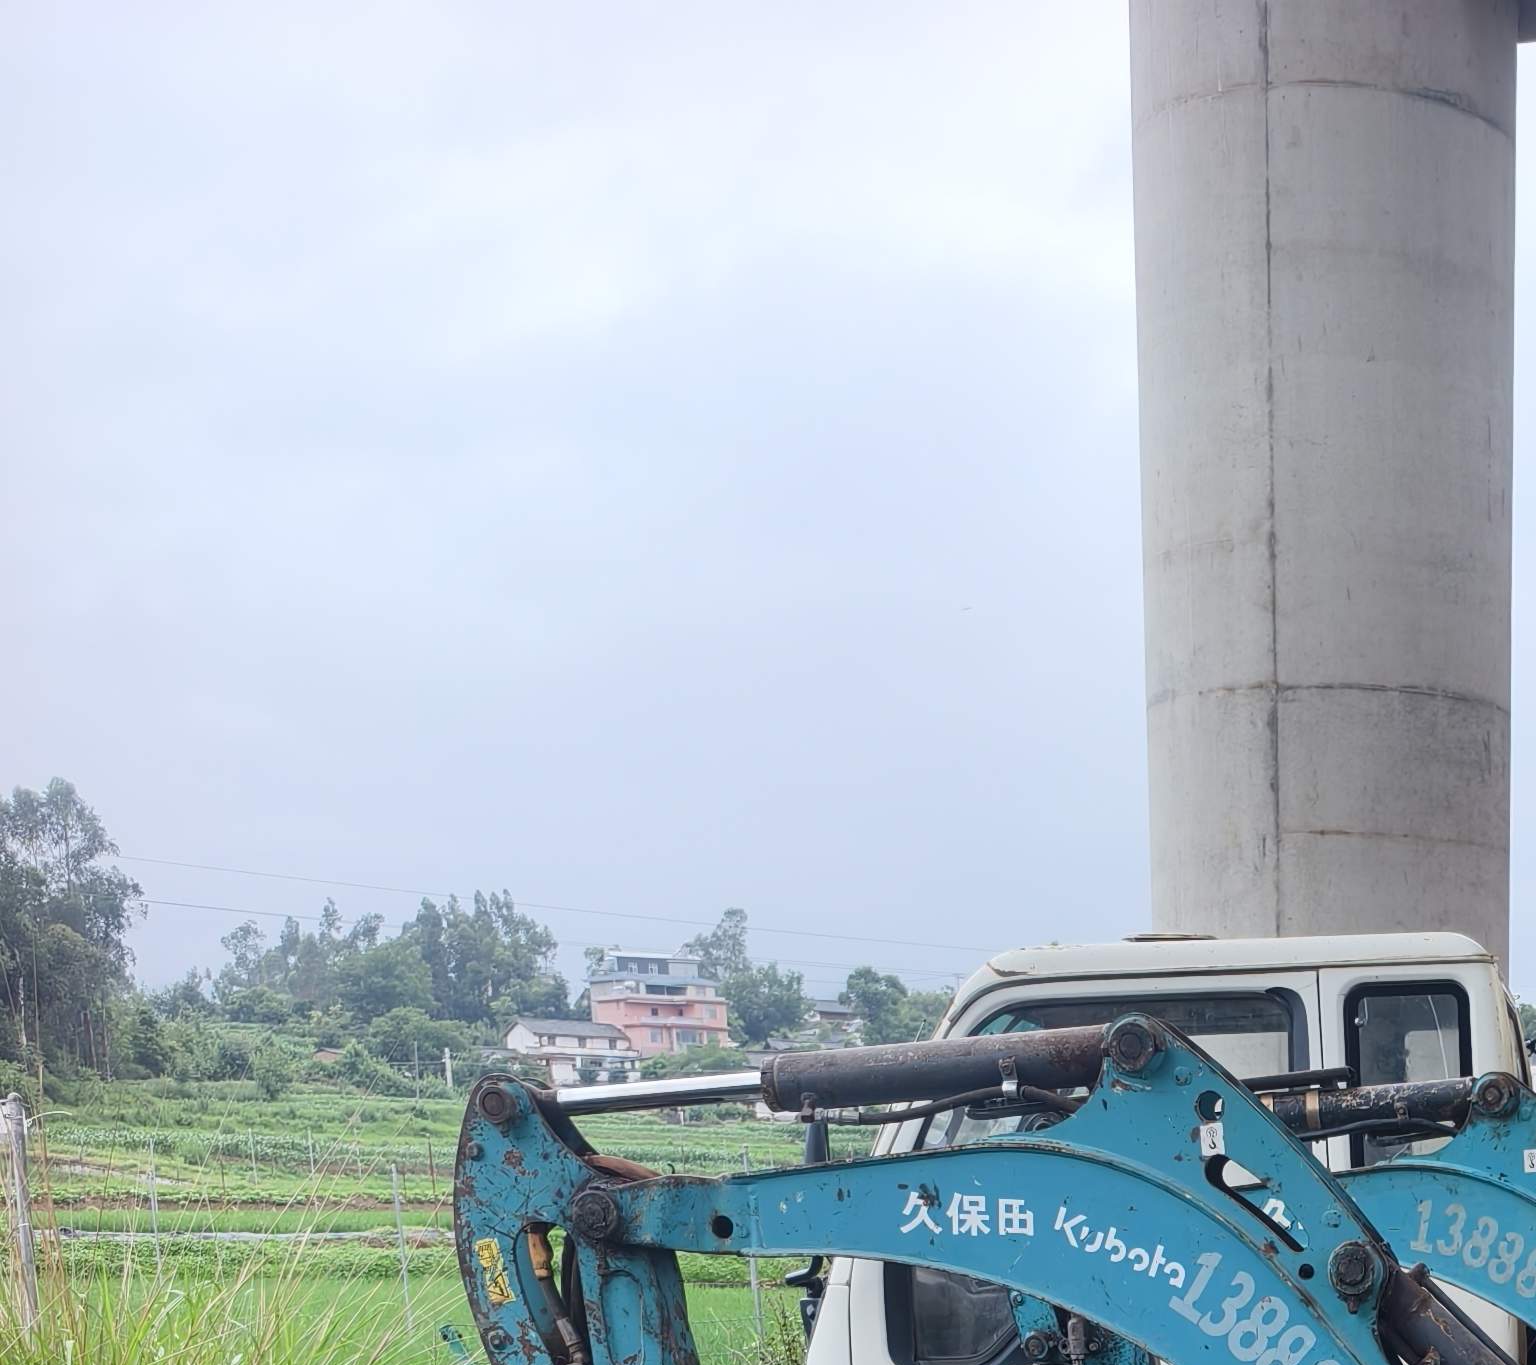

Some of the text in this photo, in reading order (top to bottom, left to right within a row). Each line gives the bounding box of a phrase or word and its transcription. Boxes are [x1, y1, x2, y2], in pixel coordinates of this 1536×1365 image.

[900, 1190, 1034, 1237] 久保田
[1053, 1206, 1186, 1288] Kubota
